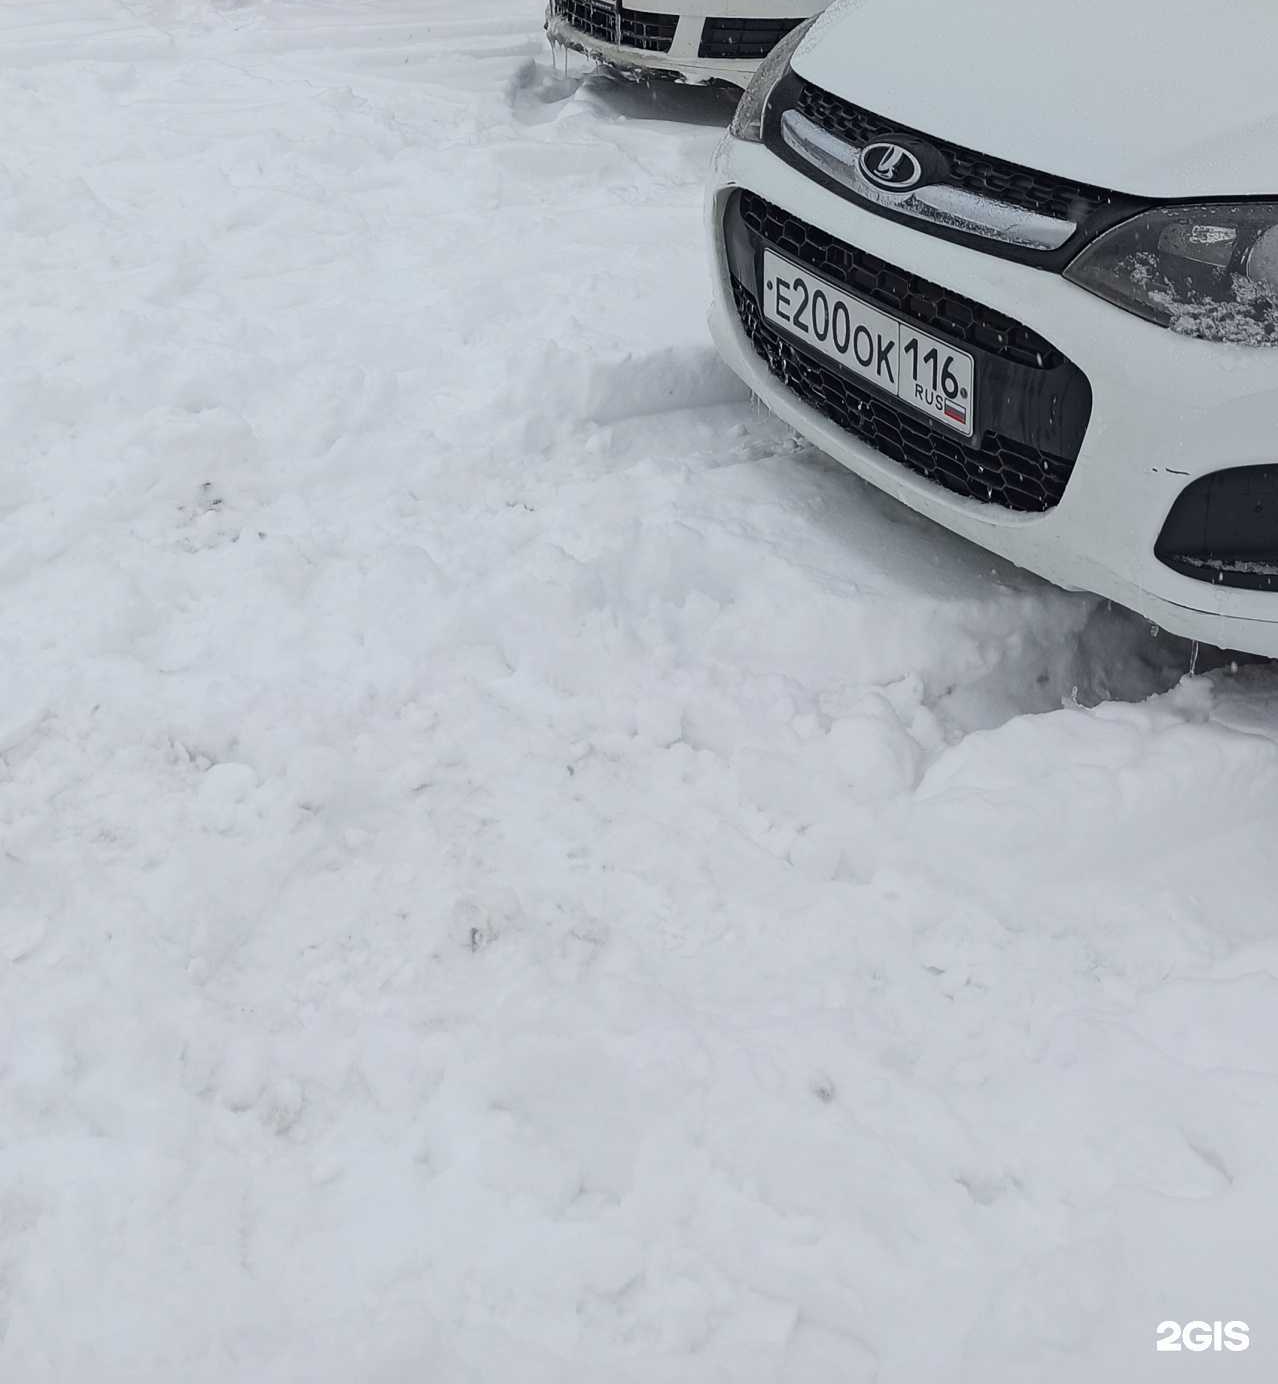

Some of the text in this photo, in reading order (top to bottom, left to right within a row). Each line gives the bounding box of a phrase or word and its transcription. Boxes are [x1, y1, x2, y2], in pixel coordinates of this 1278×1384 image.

[775, 276, 960, 400] Е200ОК 116
[914, 382, 944, 412] RUS
